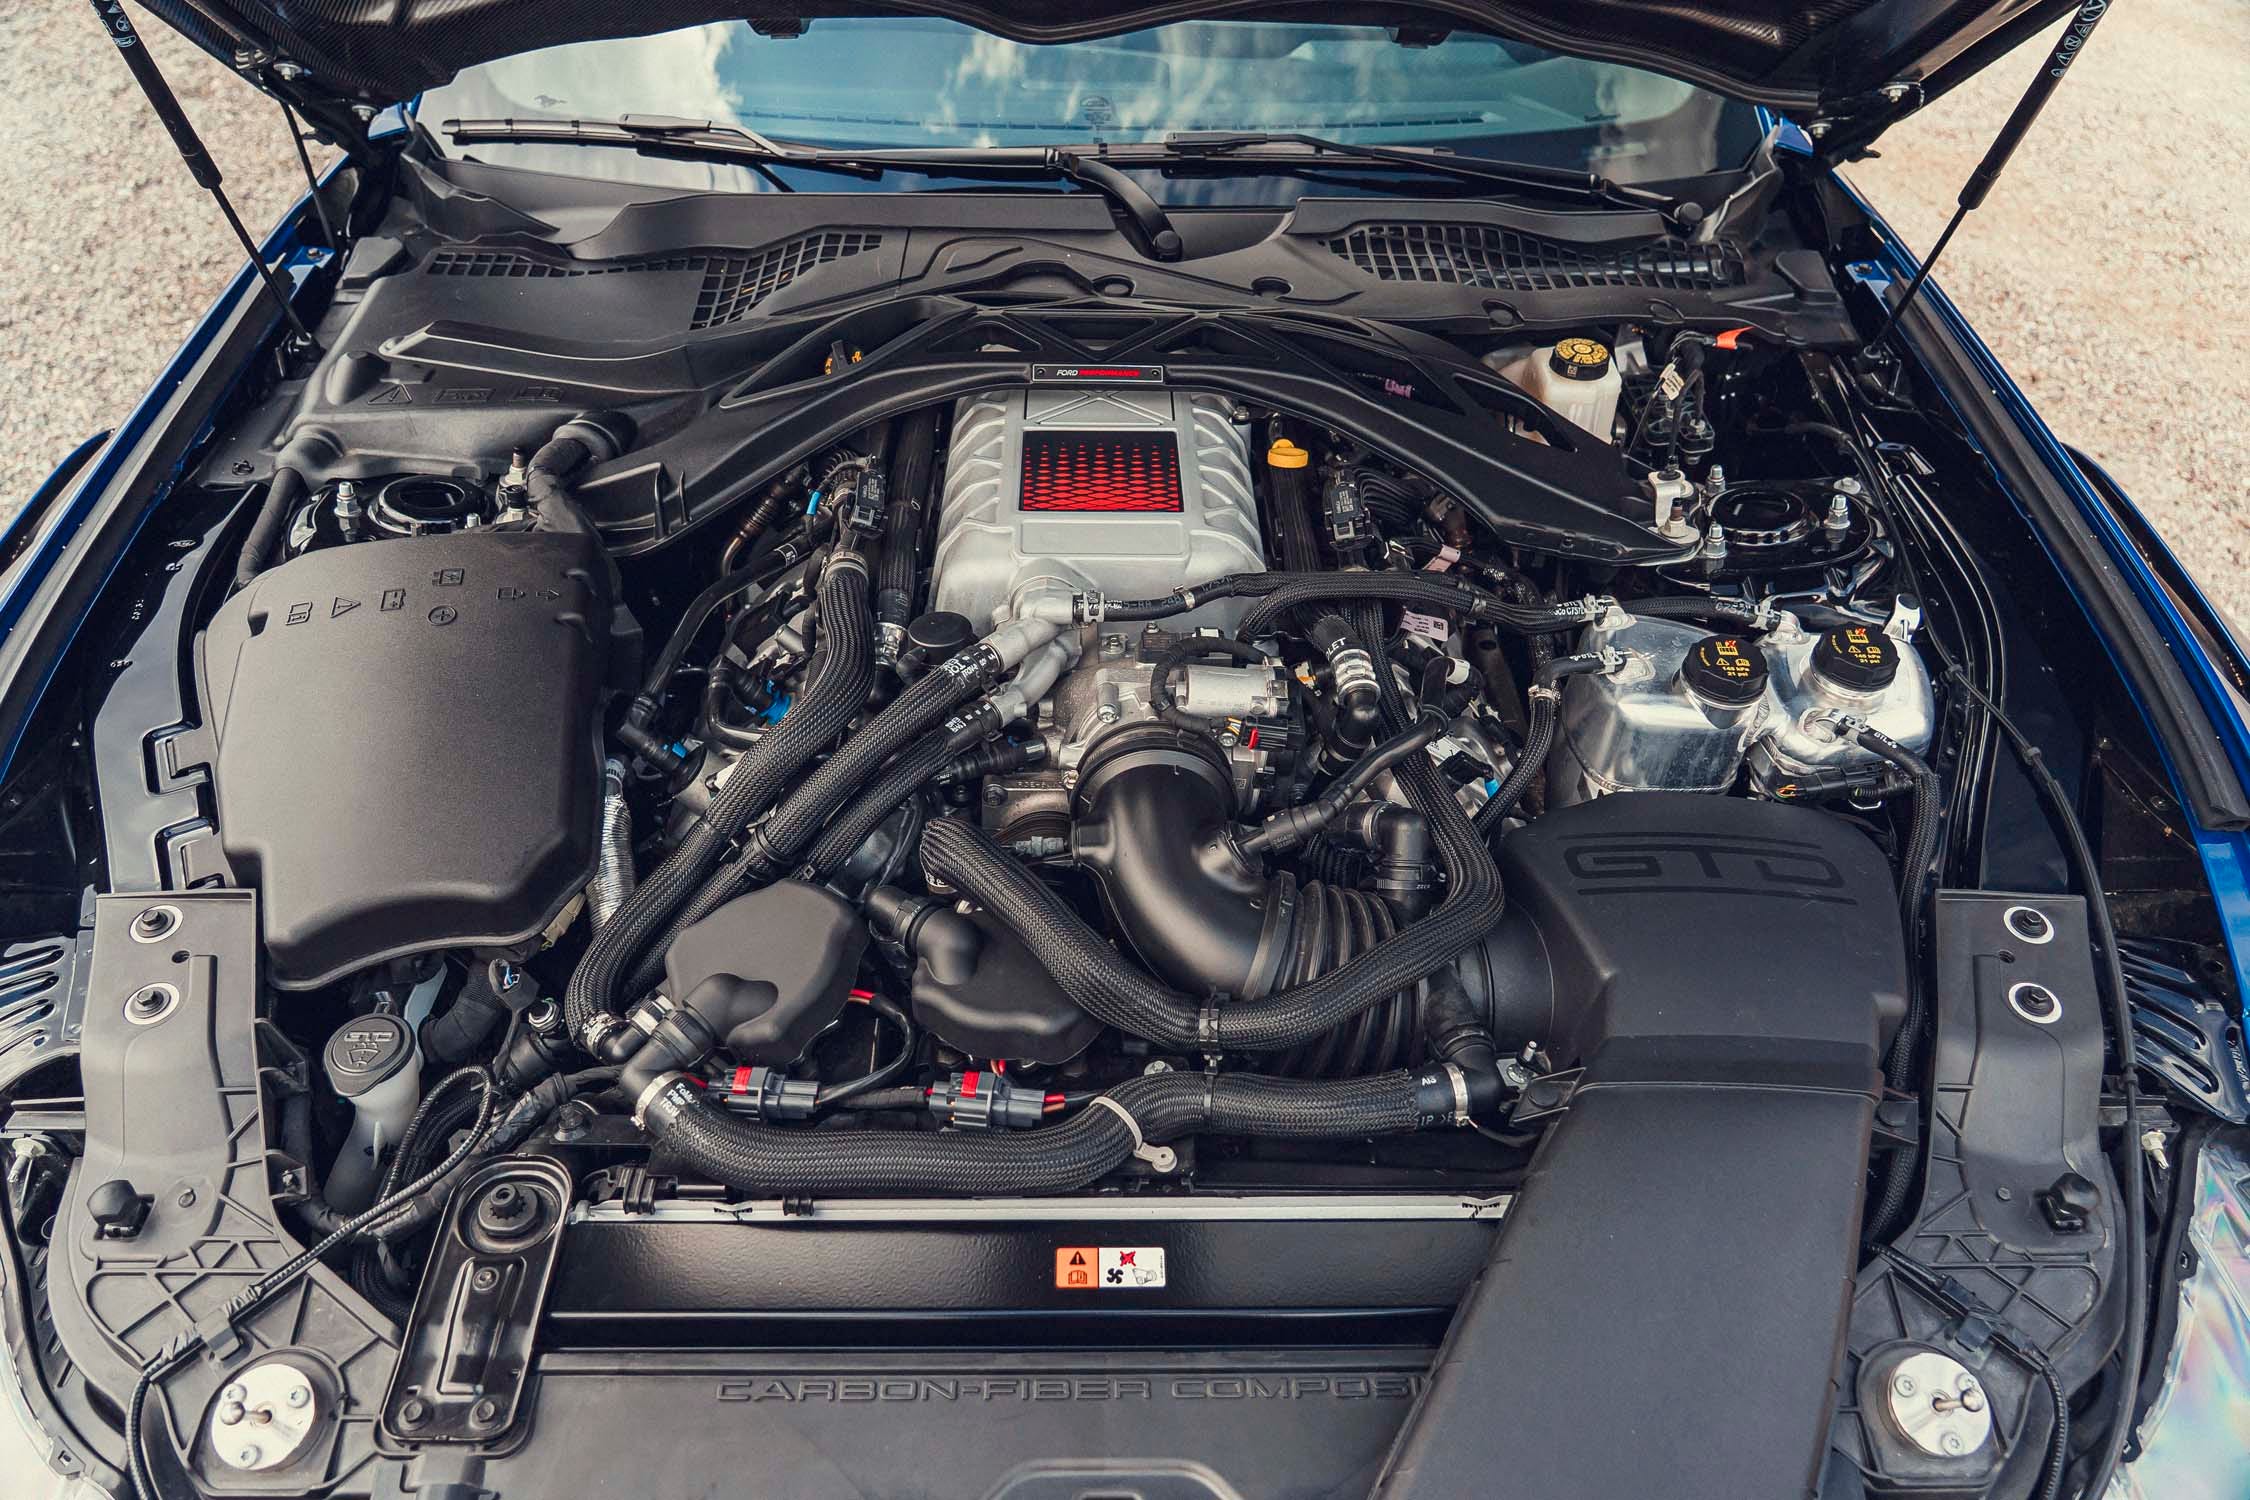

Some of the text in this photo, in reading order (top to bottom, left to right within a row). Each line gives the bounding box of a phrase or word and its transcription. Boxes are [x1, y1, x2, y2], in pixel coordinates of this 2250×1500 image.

[1079, 369, 1139, 377] PERFORMANCE
[1563, 844, 1845, 888] GTD
[344, 1031, 394, 1042] GTD
[716, 1376, 1424, 1401] CARBON-FIBER COMPOSI
